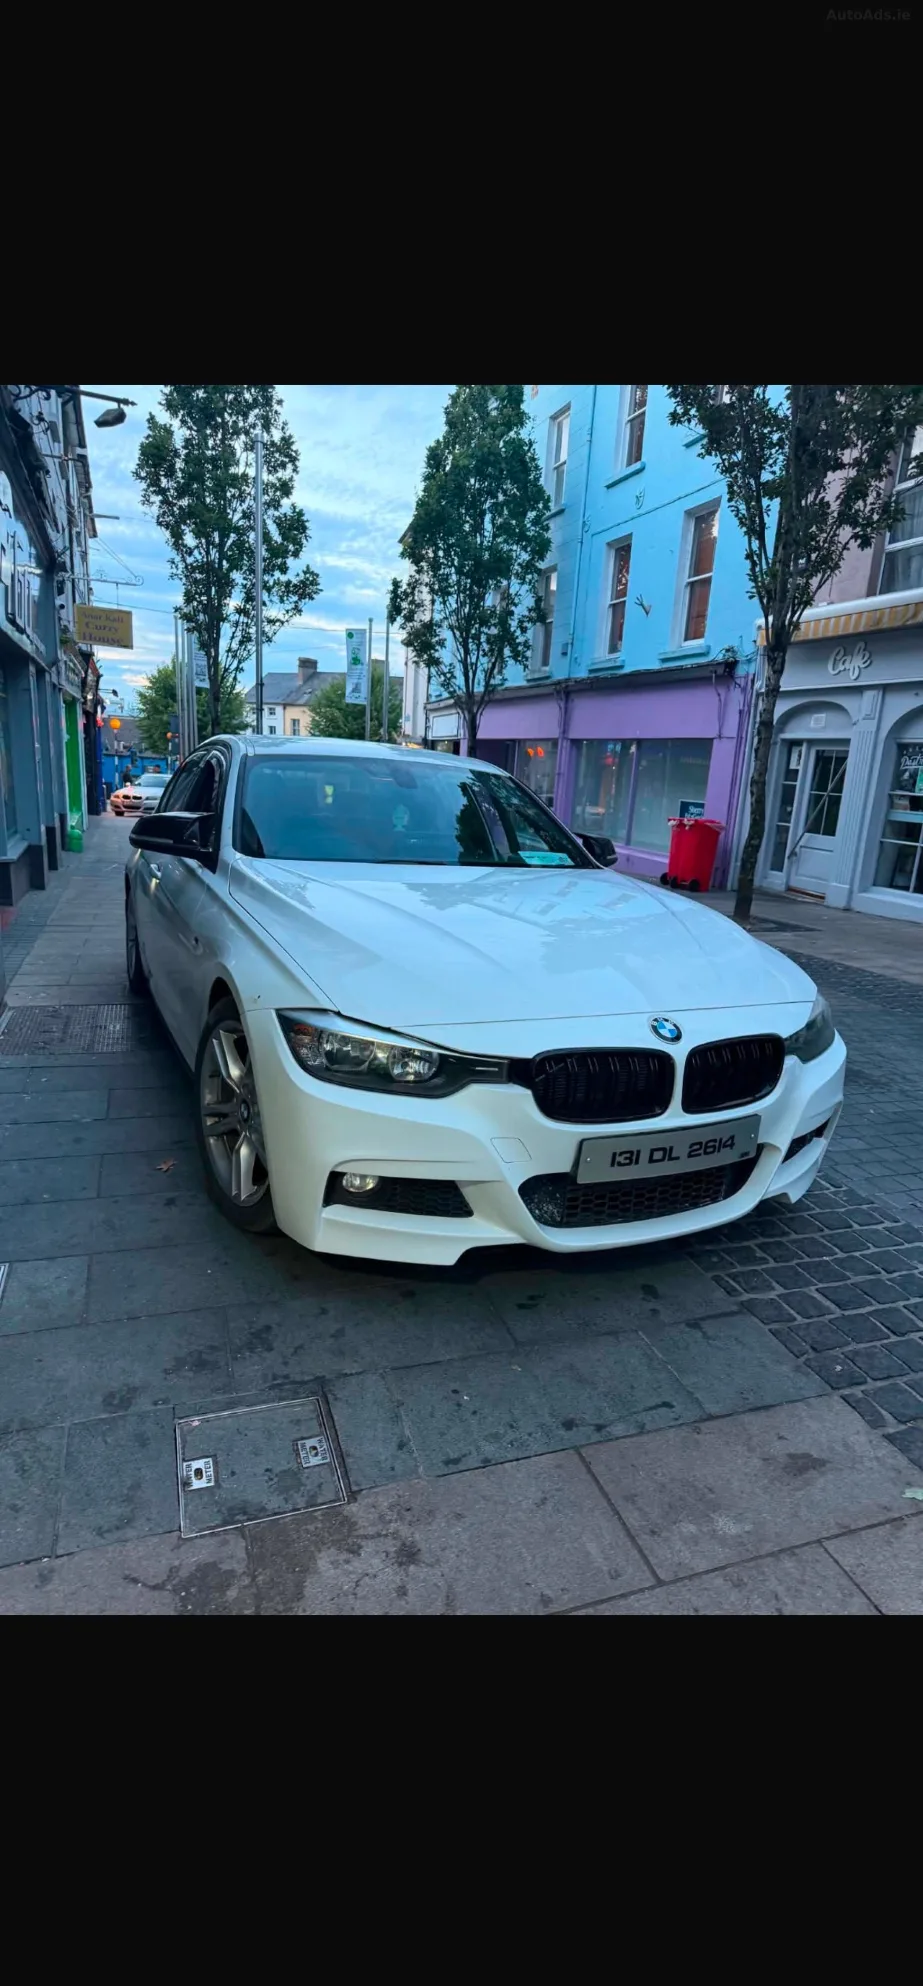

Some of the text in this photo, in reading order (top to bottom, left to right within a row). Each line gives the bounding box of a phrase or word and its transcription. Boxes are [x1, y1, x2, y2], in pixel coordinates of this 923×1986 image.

[85, 622, 118, 633] Curry
[83, 632, 123, 644] House
[610, 1150, 641, 1167] 131
[647, 1146, 680, 1164] DL
[687, 1134, 735, 1159] 2614
[203, 1460, 214, 1484] METER
